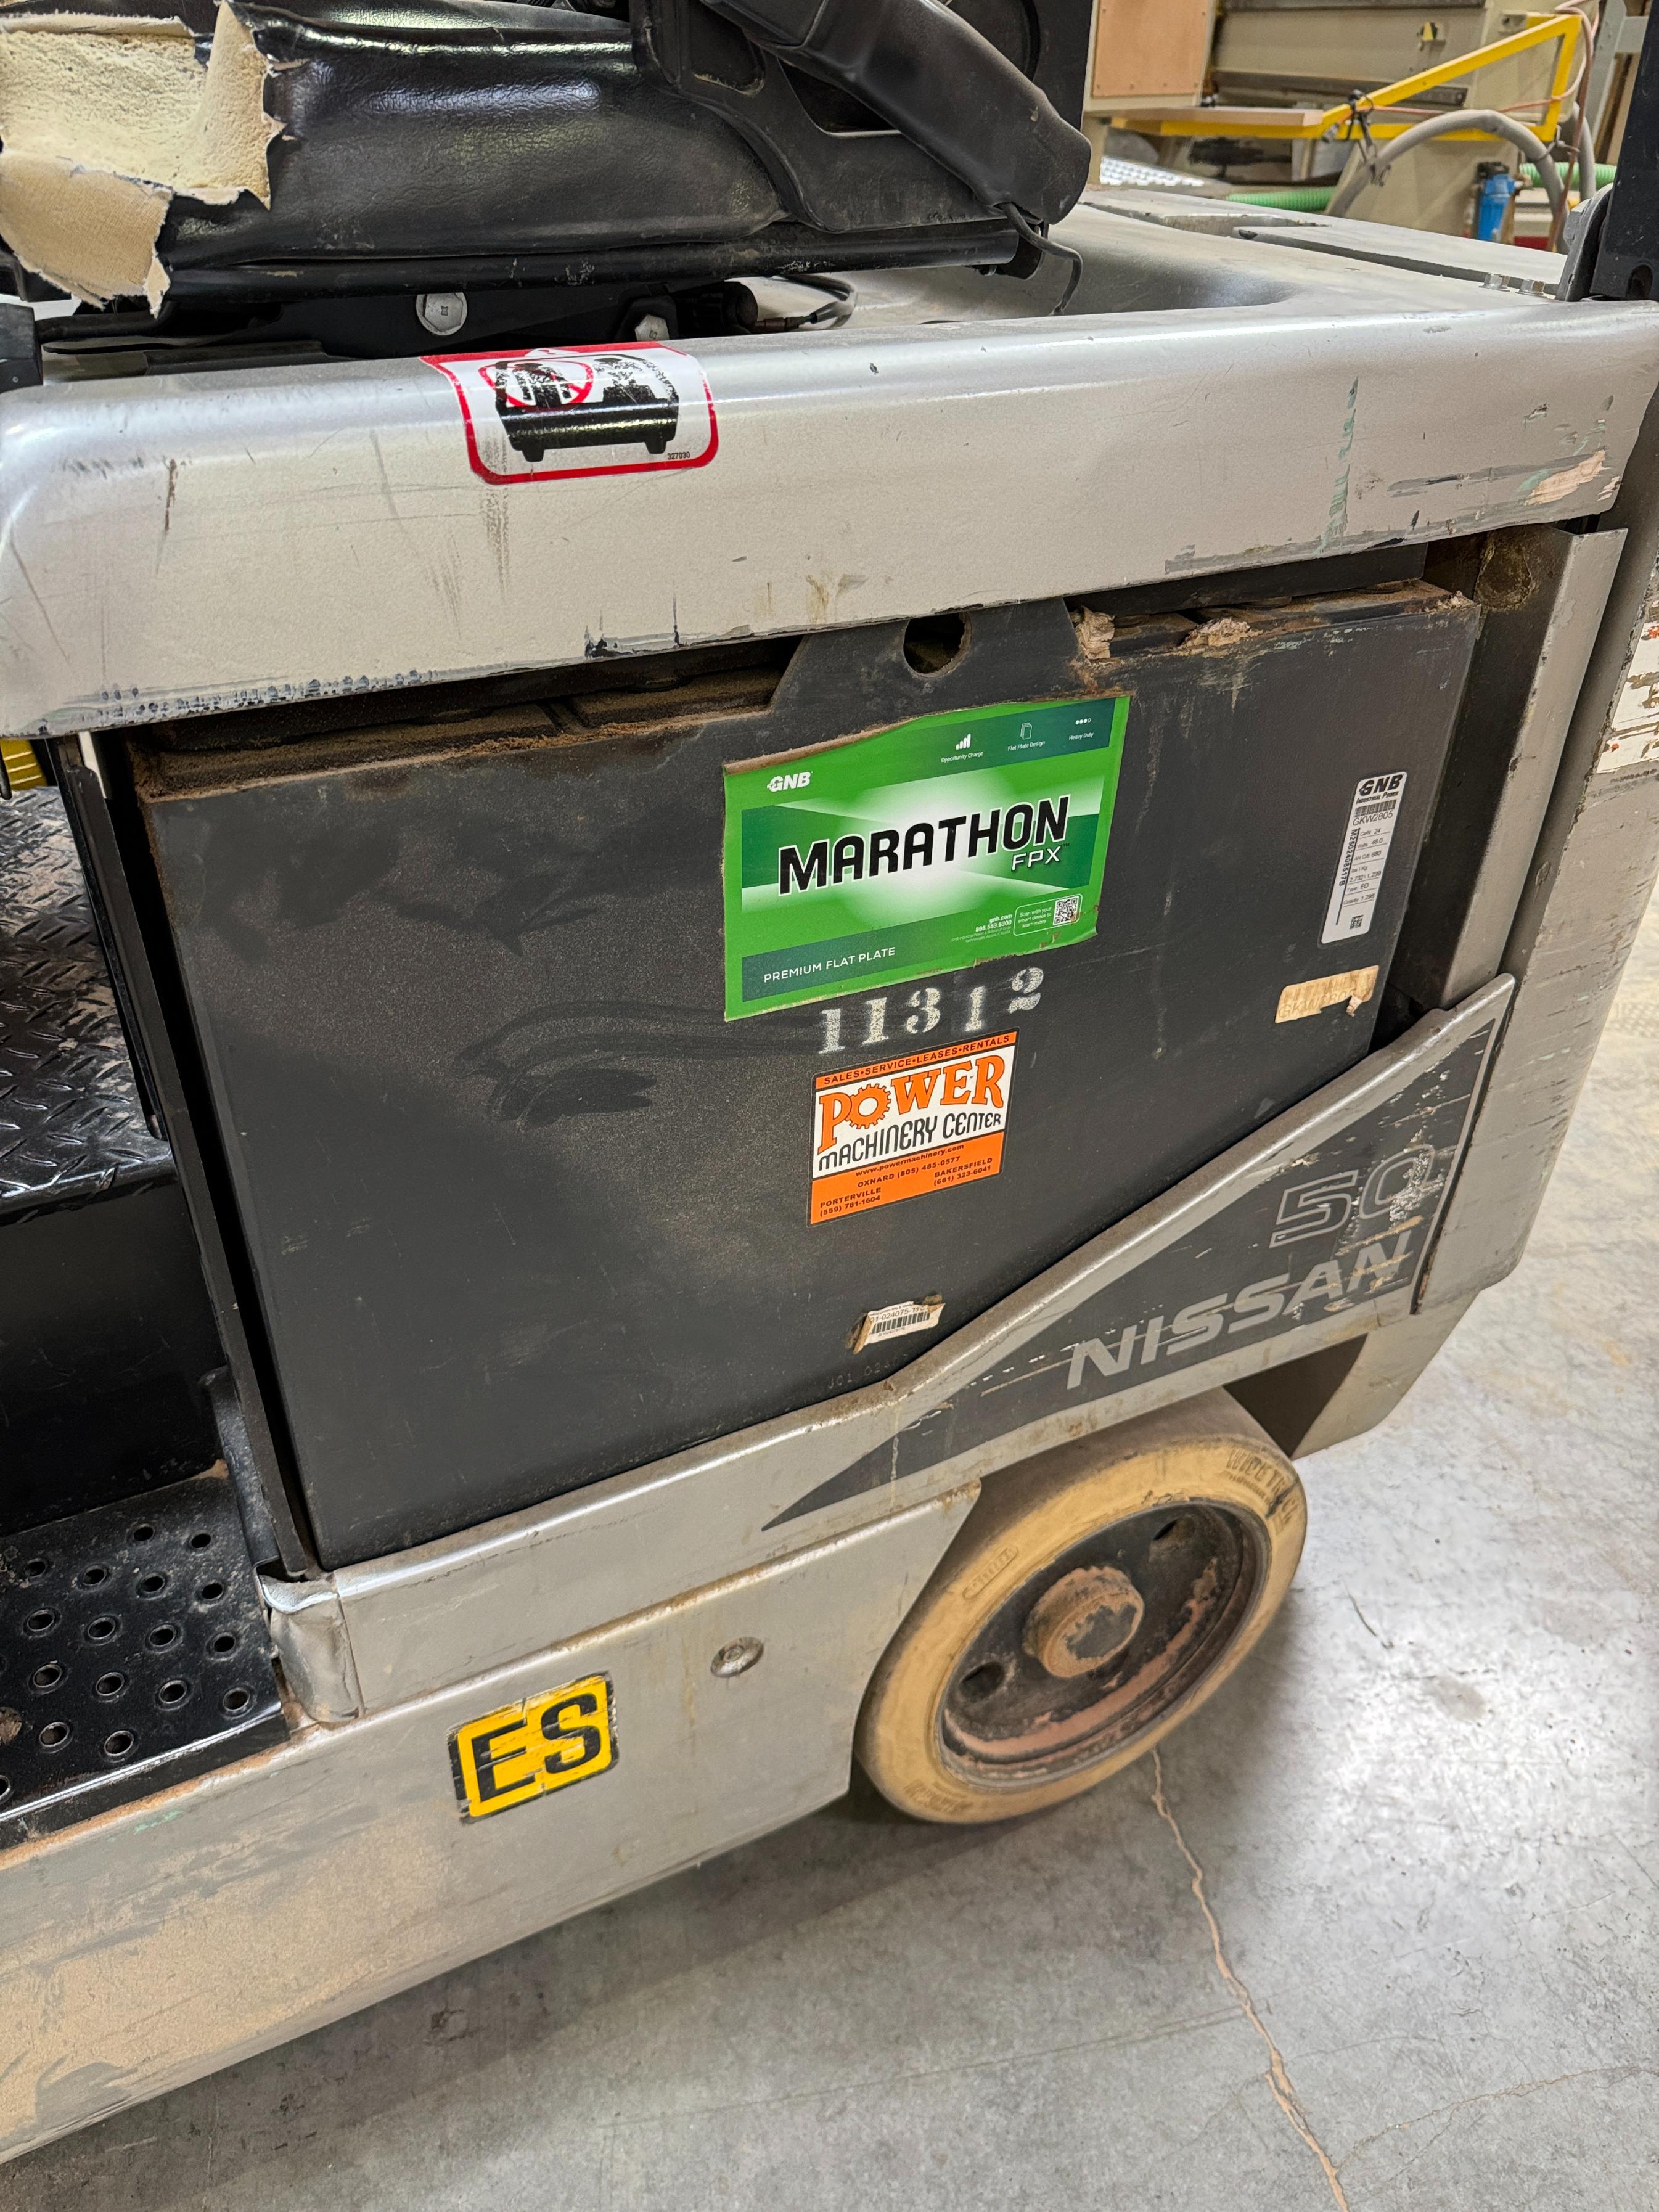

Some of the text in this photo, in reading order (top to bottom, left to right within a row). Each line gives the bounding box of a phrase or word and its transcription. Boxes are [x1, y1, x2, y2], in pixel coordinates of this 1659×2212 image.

[667, 451, 690, 460] 327030
[1029, 740, 1046, 748] Design
[941, 750, 984, 763] Opportunity Charge
[766, 771, 811, 792] GNB
[1359, 774, 1403, 796] GNB
[1353, 811, 1393, 826] GKW2805
[778, 794, 1071, 896] MARATHON
[975, 920, 1012, 932] 888.563.6300
[989, 914, 1013, 924] gnb.com
[764, 946, 896, 983] PREMIUM FLAT PLATE
[818, 967, 1044, 1054] 11312
[817, 1055, 1005, 1155] POWER
[819, 1112, 1001, 1171] MACHINERY CENTER
[855, 1144, 964, 1177] www.powermachinery.com
[858, 1156, 961, 1187] OXNARD (805) 485-0577
[934, 1157, 993, 1178] BAKERSFIELD
[933, 1165, 991, 1186] (661) 323-6041
[820, 1187, 882, 1208] PORTERVILLE
[820, 1195, 881, 1217] (559) 781-1604
[1269, 1144, 1435, 1248] 50
[1067, 1229, 1412, 1390] NISSAN
[1266, 1469, 1299, 1525] TRCK
[472, 1693, 601, 1802] ES
